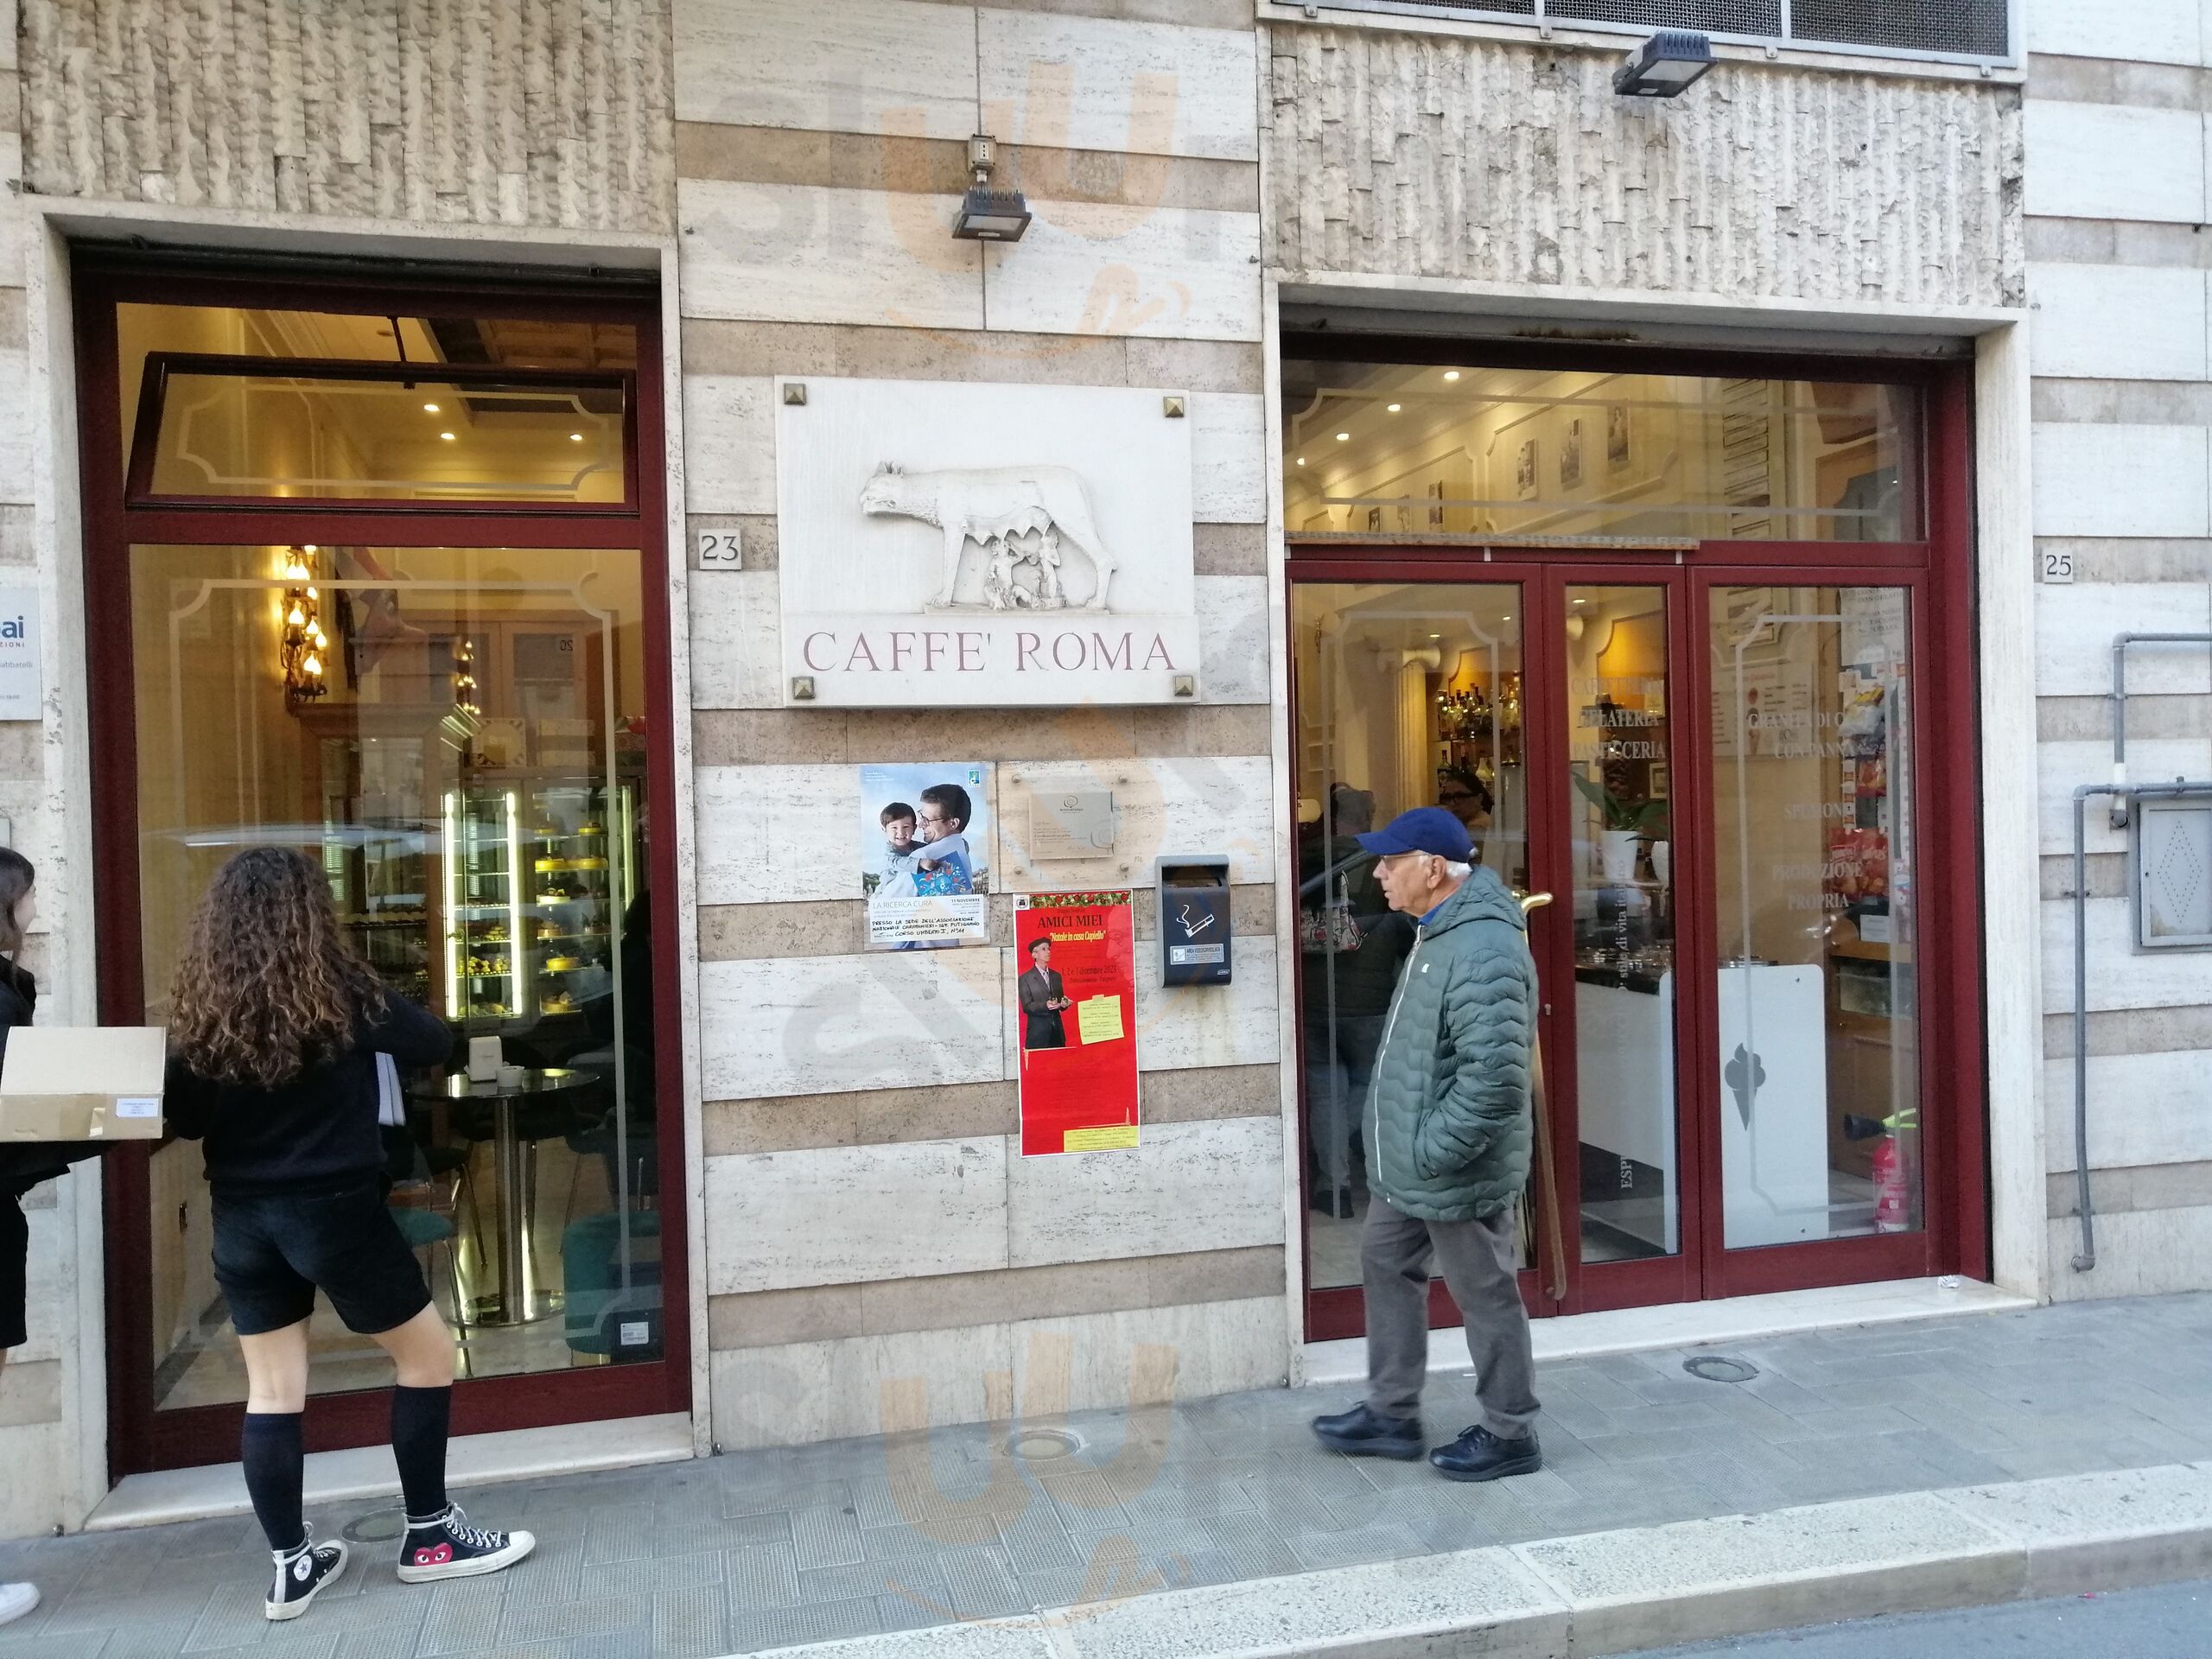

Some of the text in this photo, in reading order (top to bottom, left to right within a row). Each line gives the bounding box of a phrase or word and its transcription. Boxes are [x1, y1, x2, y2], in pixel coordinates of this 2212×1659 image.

[702, 535, 739, 561] 23
[2046, 554, 2072, 575] 25
[0, 615, 24, 639] ai
[803, 632, 1177, 671] CAFFE' ROMA
[883, 900, 912, 909] RICERCA
[1788, 893, 1850, 910] PROPRIA
[1038, 914, 1103, 929] AMICI MIEI
[1615, 911, 1627, 933] vita
